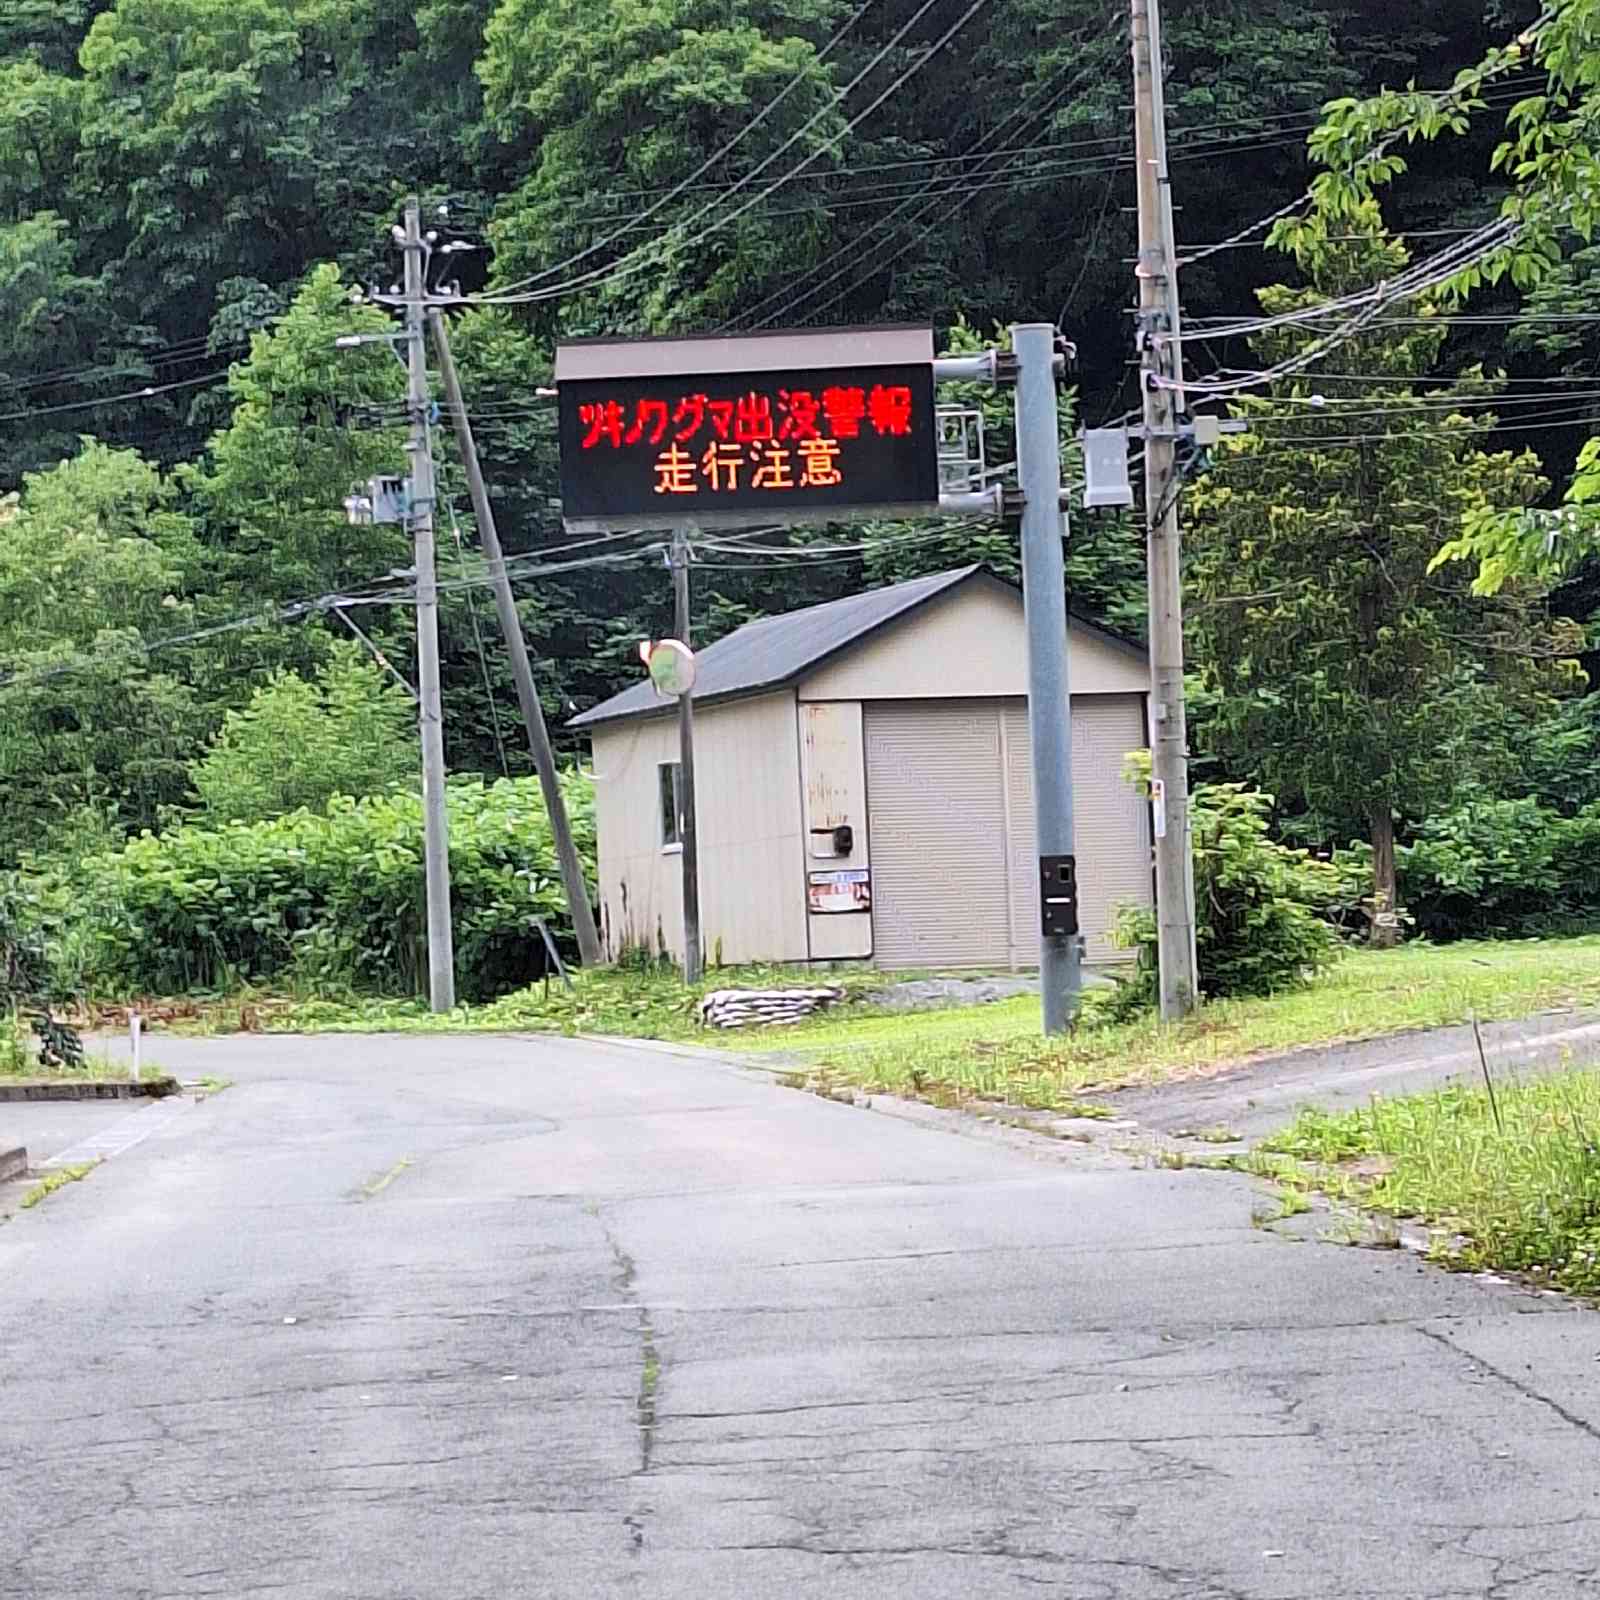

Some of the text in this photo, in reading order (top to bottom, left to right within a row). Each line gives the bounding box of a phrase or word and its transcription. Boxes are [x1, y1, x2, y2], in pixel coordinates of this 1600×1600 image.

[579, 384, 912, 448] ツキノワグマ出没警報
[653, 437, 843, 493] 走行注意
